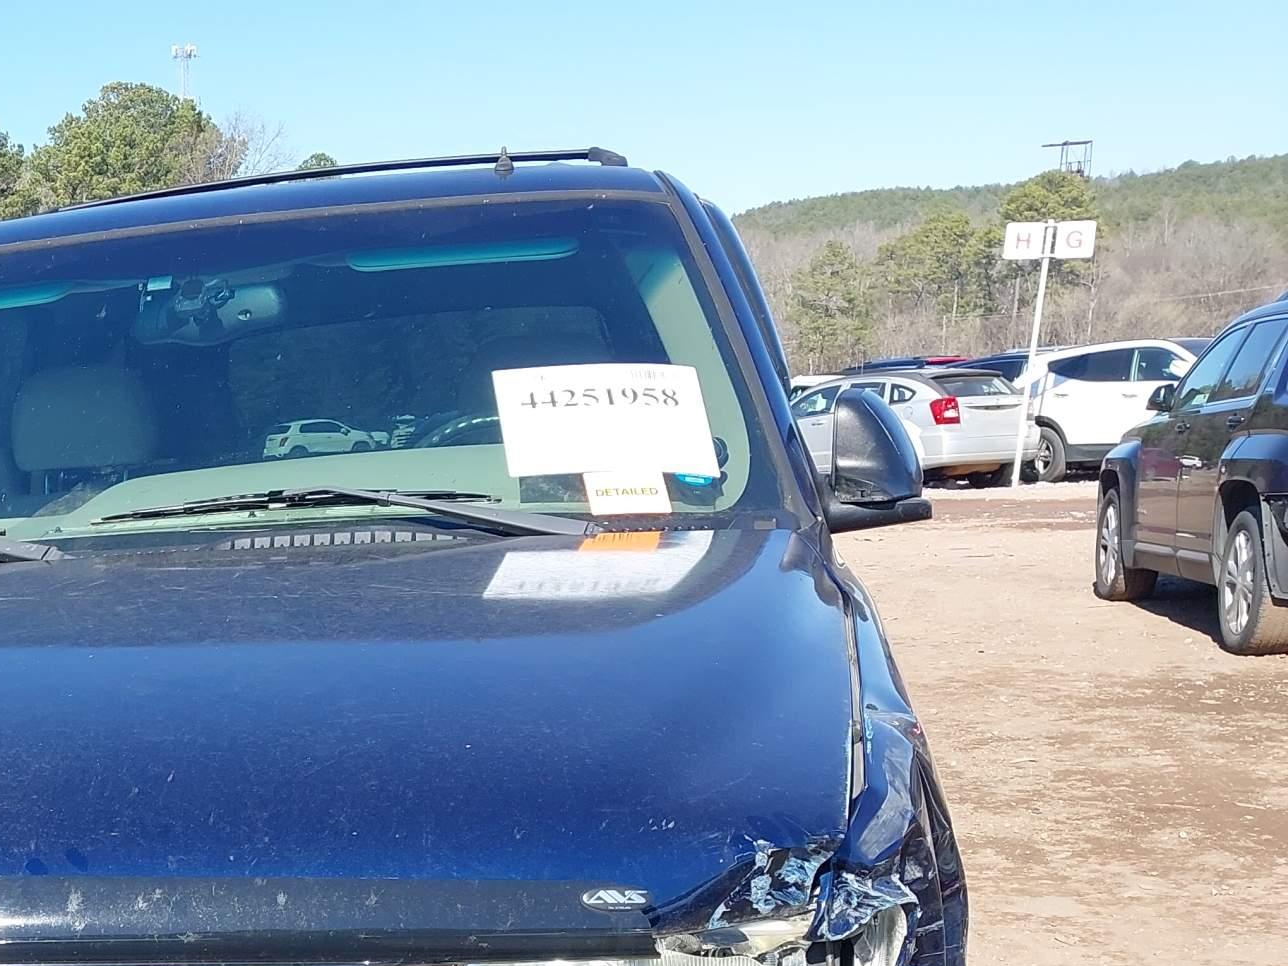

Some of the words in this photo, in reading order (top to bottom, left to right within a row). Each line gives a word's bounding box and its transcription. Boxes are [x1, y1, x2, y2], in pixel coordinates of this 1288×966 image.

[1016, 232, 1031, 248] H
[1066, 231, 1083, 248] G
[521, 387, 679, 408] 44251958
[595, 487, 658, 498] DETAILED
[586, 889, 648, 904] AVS
